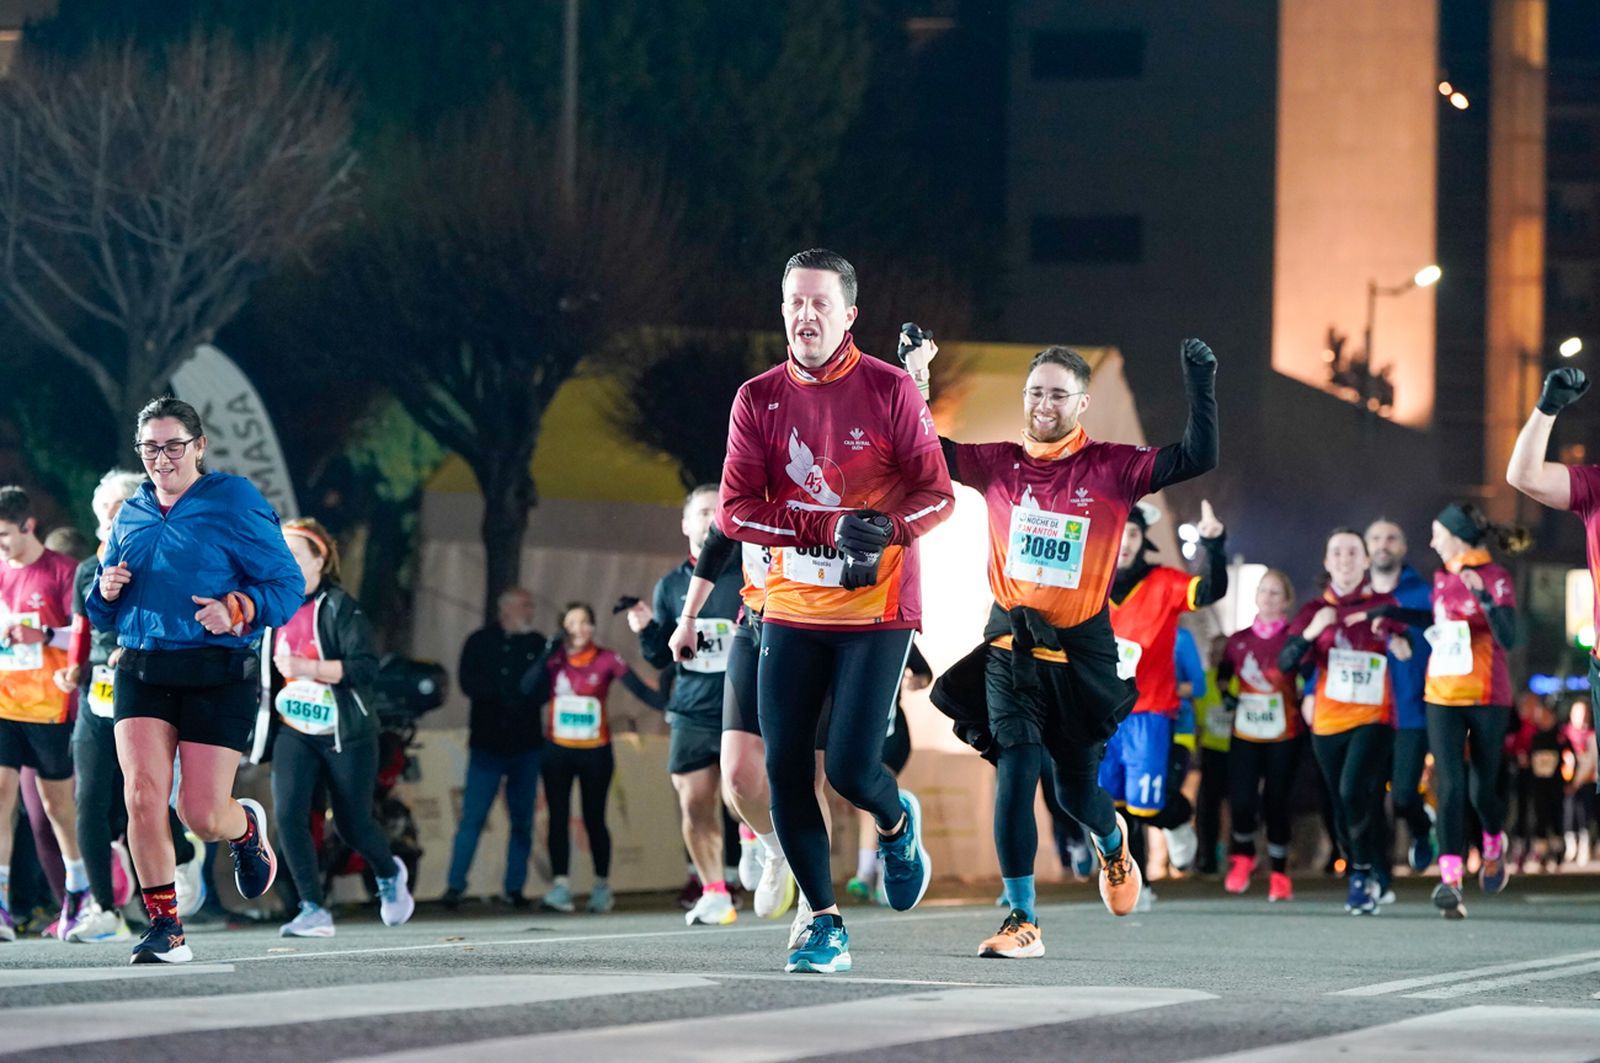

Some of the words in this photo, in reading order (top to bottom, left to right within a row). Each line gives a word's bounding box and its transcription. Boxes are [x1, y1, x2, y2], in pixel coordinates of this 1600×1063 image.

[804, 472, 823, 495] 43
[1021, 534, 1071, 562] 3089
[285, 700, 330, 721] 13697
[1138, 773, 1163, 804] 11
